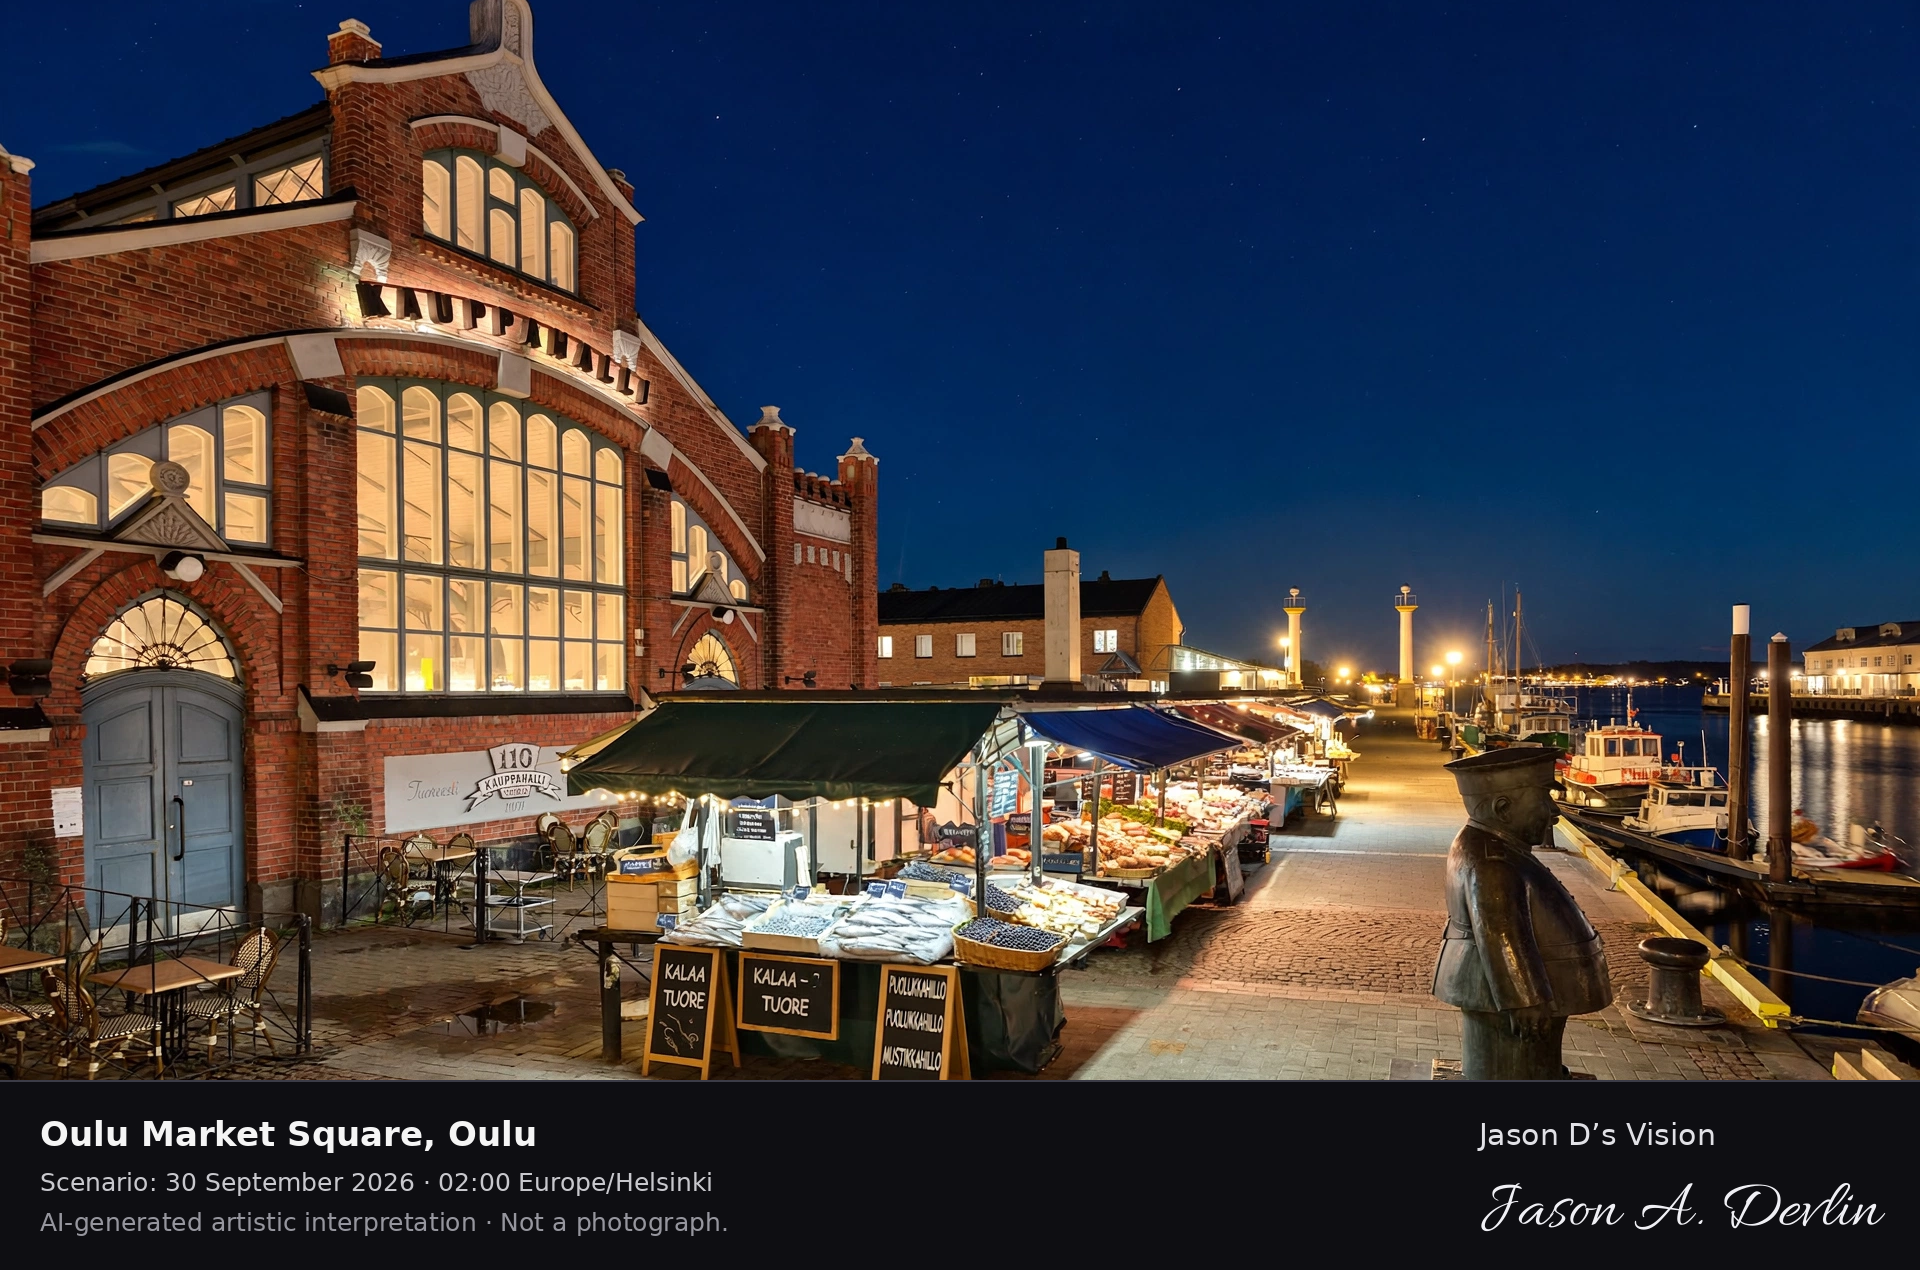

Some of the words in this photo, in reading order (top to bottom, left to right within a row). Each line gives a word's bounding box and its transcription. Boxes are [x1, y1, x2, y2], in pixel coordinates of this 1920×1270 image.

[355, 283, 651, 405] KAUPPAHALLI
[499, 747, 532, 770] 110
[484, 773, 546, 791] KAUPPAHALLI
[664, 963, 706, 983] KALAA
[753, 967, 797, 988] KALAA
[663, 989, 706, 1010] TUORE
[761, 995, 810, 1017] TUORE
